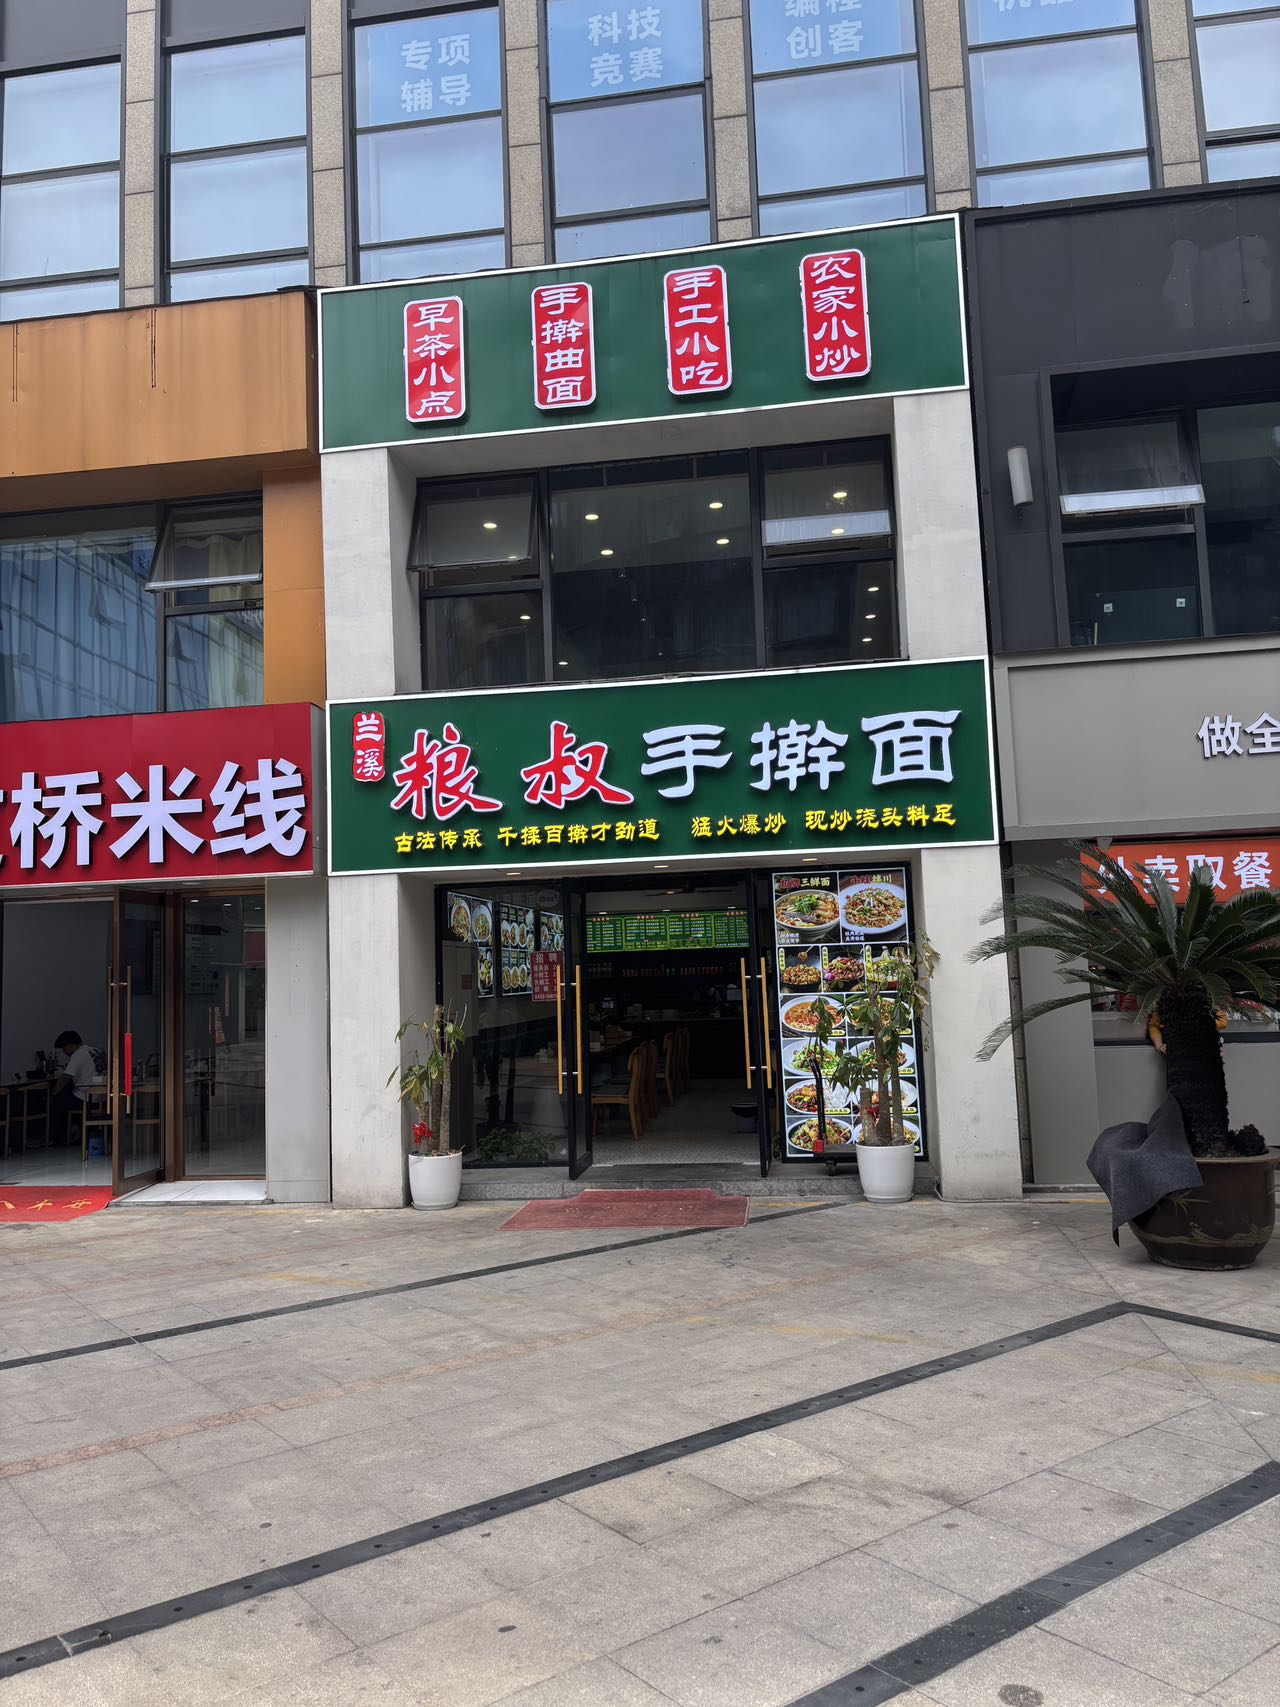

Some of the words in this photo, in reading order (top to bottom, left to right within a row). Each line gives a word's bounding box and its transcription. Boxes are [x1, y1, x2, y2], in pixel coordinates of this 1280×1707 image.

[587, 6, 663, 46] 科技
[786, 19, 864, 59] 创客
[400, 34, 471, 71] 专项
[590, 47, 664, 88] 竞赛
[400, 74, 471, 112] 辅导
[673, 271, 724, 385] 手工小吃
[810, 256, 862, 372] 农家小炒
[413, 303, 457, 416] 早茶小点
[540, 287, 586, 404] 手擀曲面
[355, 713, 383, 778] 兰溪
[1197, 712, 1280, 758] 做全
[0, 758, 308, 870] 桥米线
[394, 828, 483, 853] 古法传承
[497, 818, 660, 847] 千揉百擀才劲道
[691, 812, 787, 838] 猛火爆炒
[805, 803, 957, 831] 现炒浇头料足
